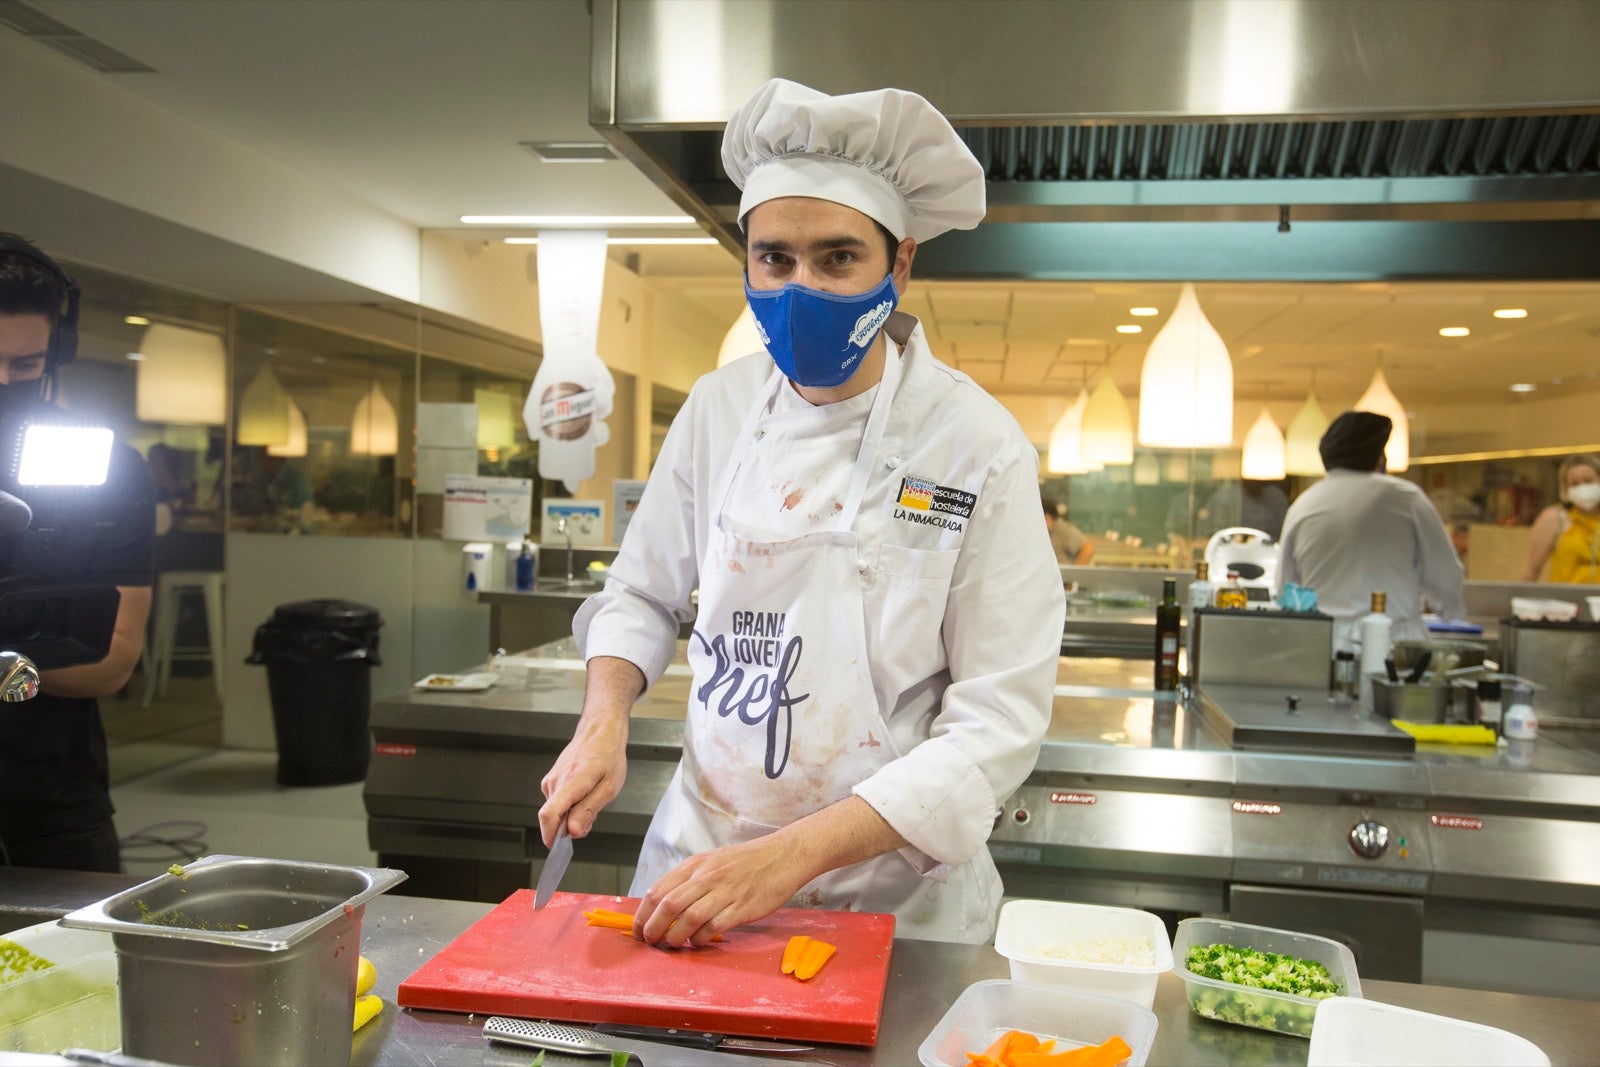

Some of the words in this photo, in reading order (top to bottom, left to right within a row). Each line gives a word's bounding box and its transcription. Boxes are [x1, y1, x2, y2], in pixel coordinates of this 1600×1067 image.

[841, 353, 857, 369] GRX
[934, 489, 964, 502] escuela
[964, 495, 974, 505] de
[930, 499, 970, 516] hostelería
[893, 509, 906, 520] LA
[907, 512, 962, 533] INMACULADA
